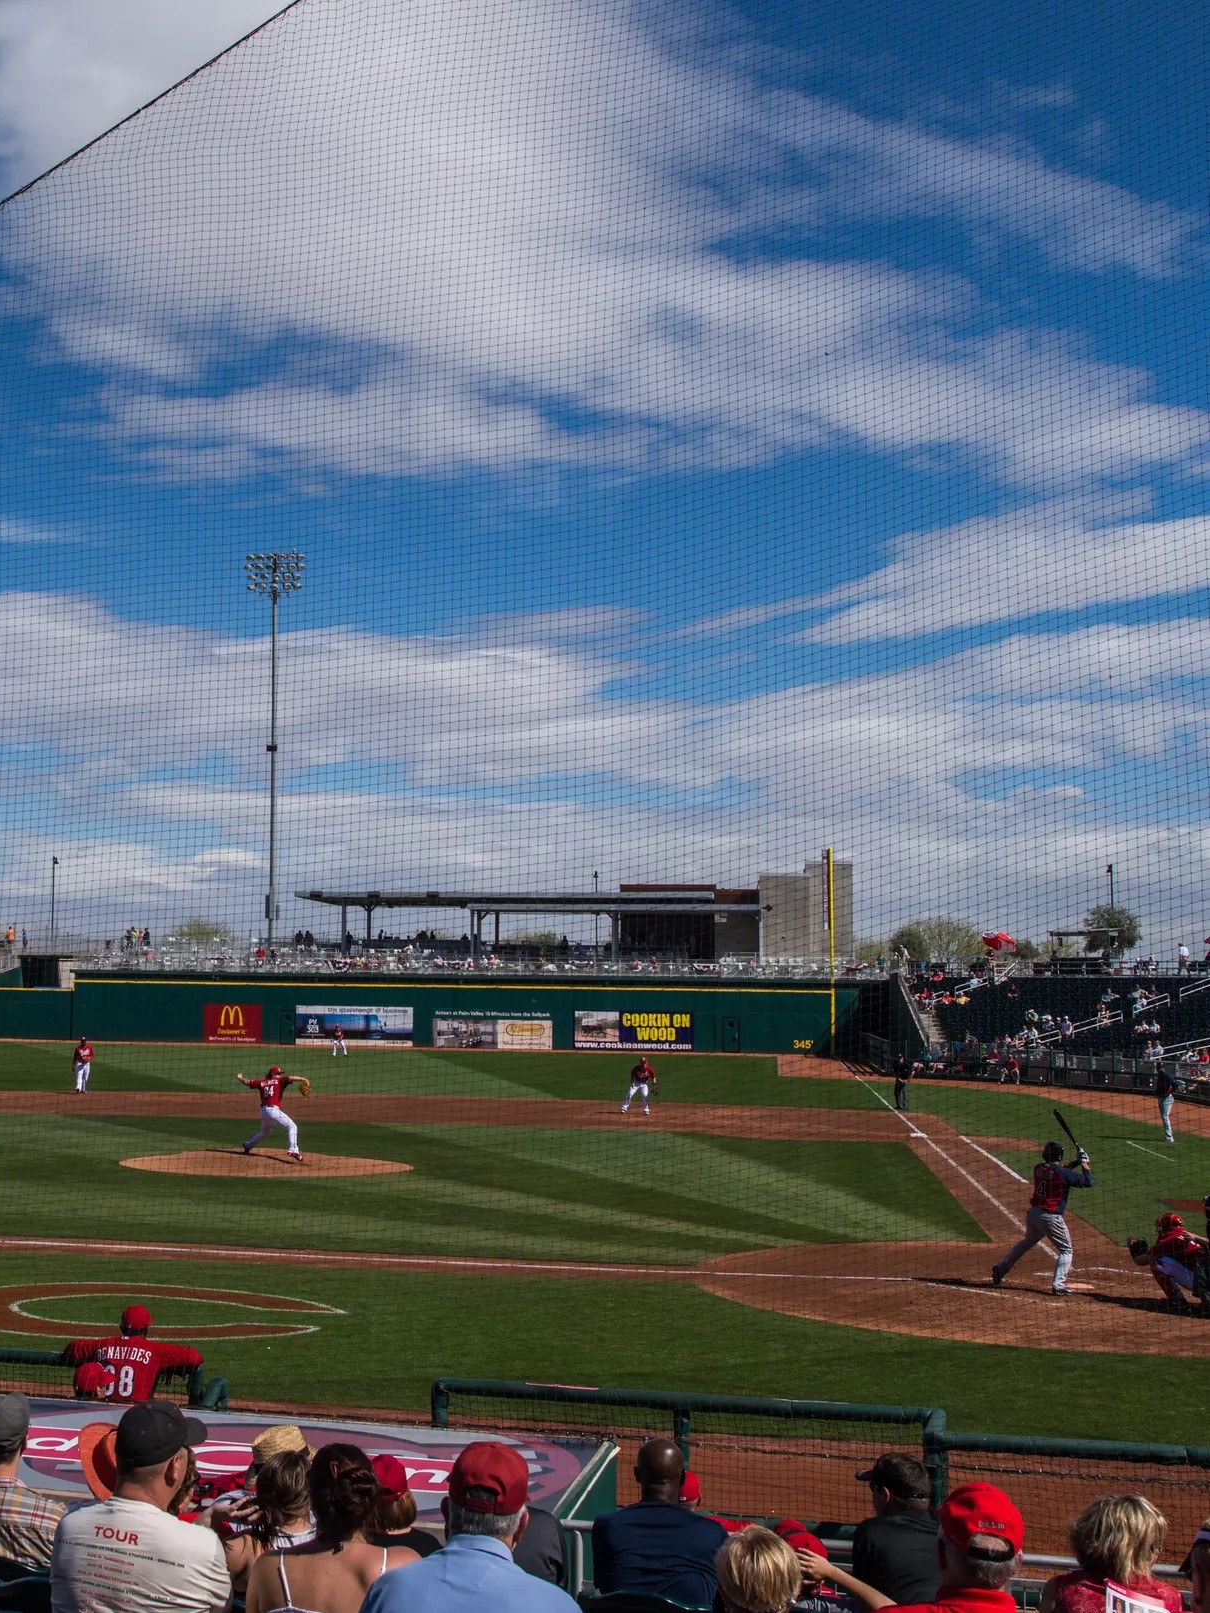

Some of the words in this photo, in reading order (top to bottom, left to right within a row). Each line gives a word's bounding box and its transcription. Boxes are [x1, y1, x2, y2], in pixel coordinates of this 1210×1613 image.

[622, 1013, 669, 1027] COOKIN
[673, 1014, 691, 1027] ON
[307, 1025, 319, 1033] 303
[636, 1027, 676, 1041] WOOD
[574, 1041, 692, 1050] www.cookinonwood.com
[97, 1346, 152, 1365] BENAVIDES
[94, 1526, 139, 1545] TOUR
[128, 1552, 154, 1561] STOPOVER
